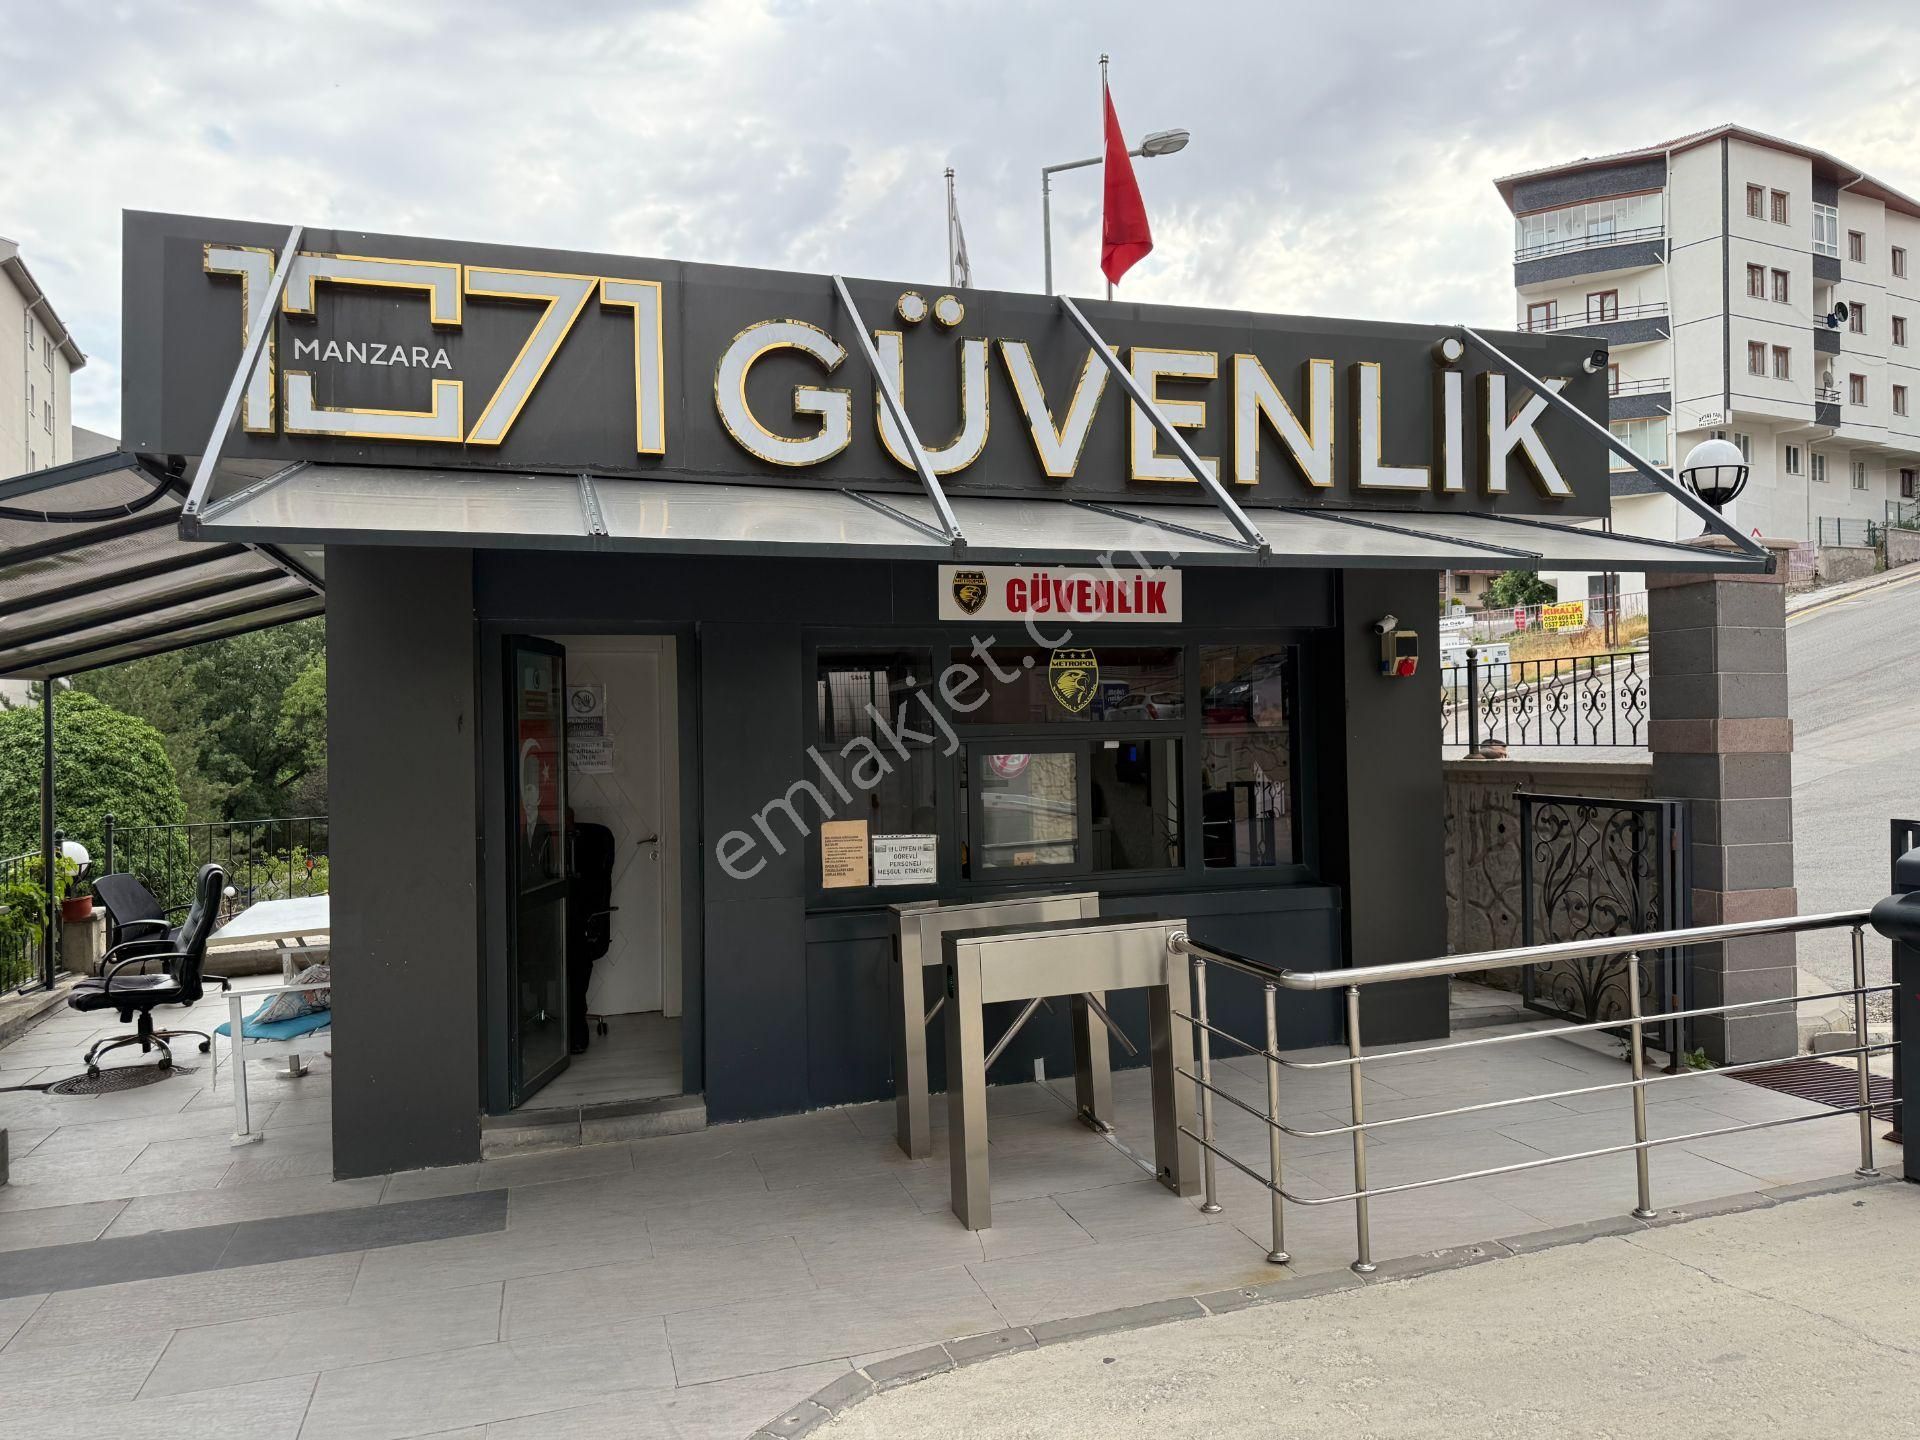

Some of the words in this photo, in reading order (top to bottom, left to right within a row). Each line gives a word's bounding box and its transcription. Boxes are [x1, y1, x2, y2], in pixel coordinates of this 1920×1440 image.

[294, 338, 452, 370] MANZARA
[714, 290, 1576, 497] GÜVENLİK
[1006, 572, 1168, 614] GÜVENLİK
